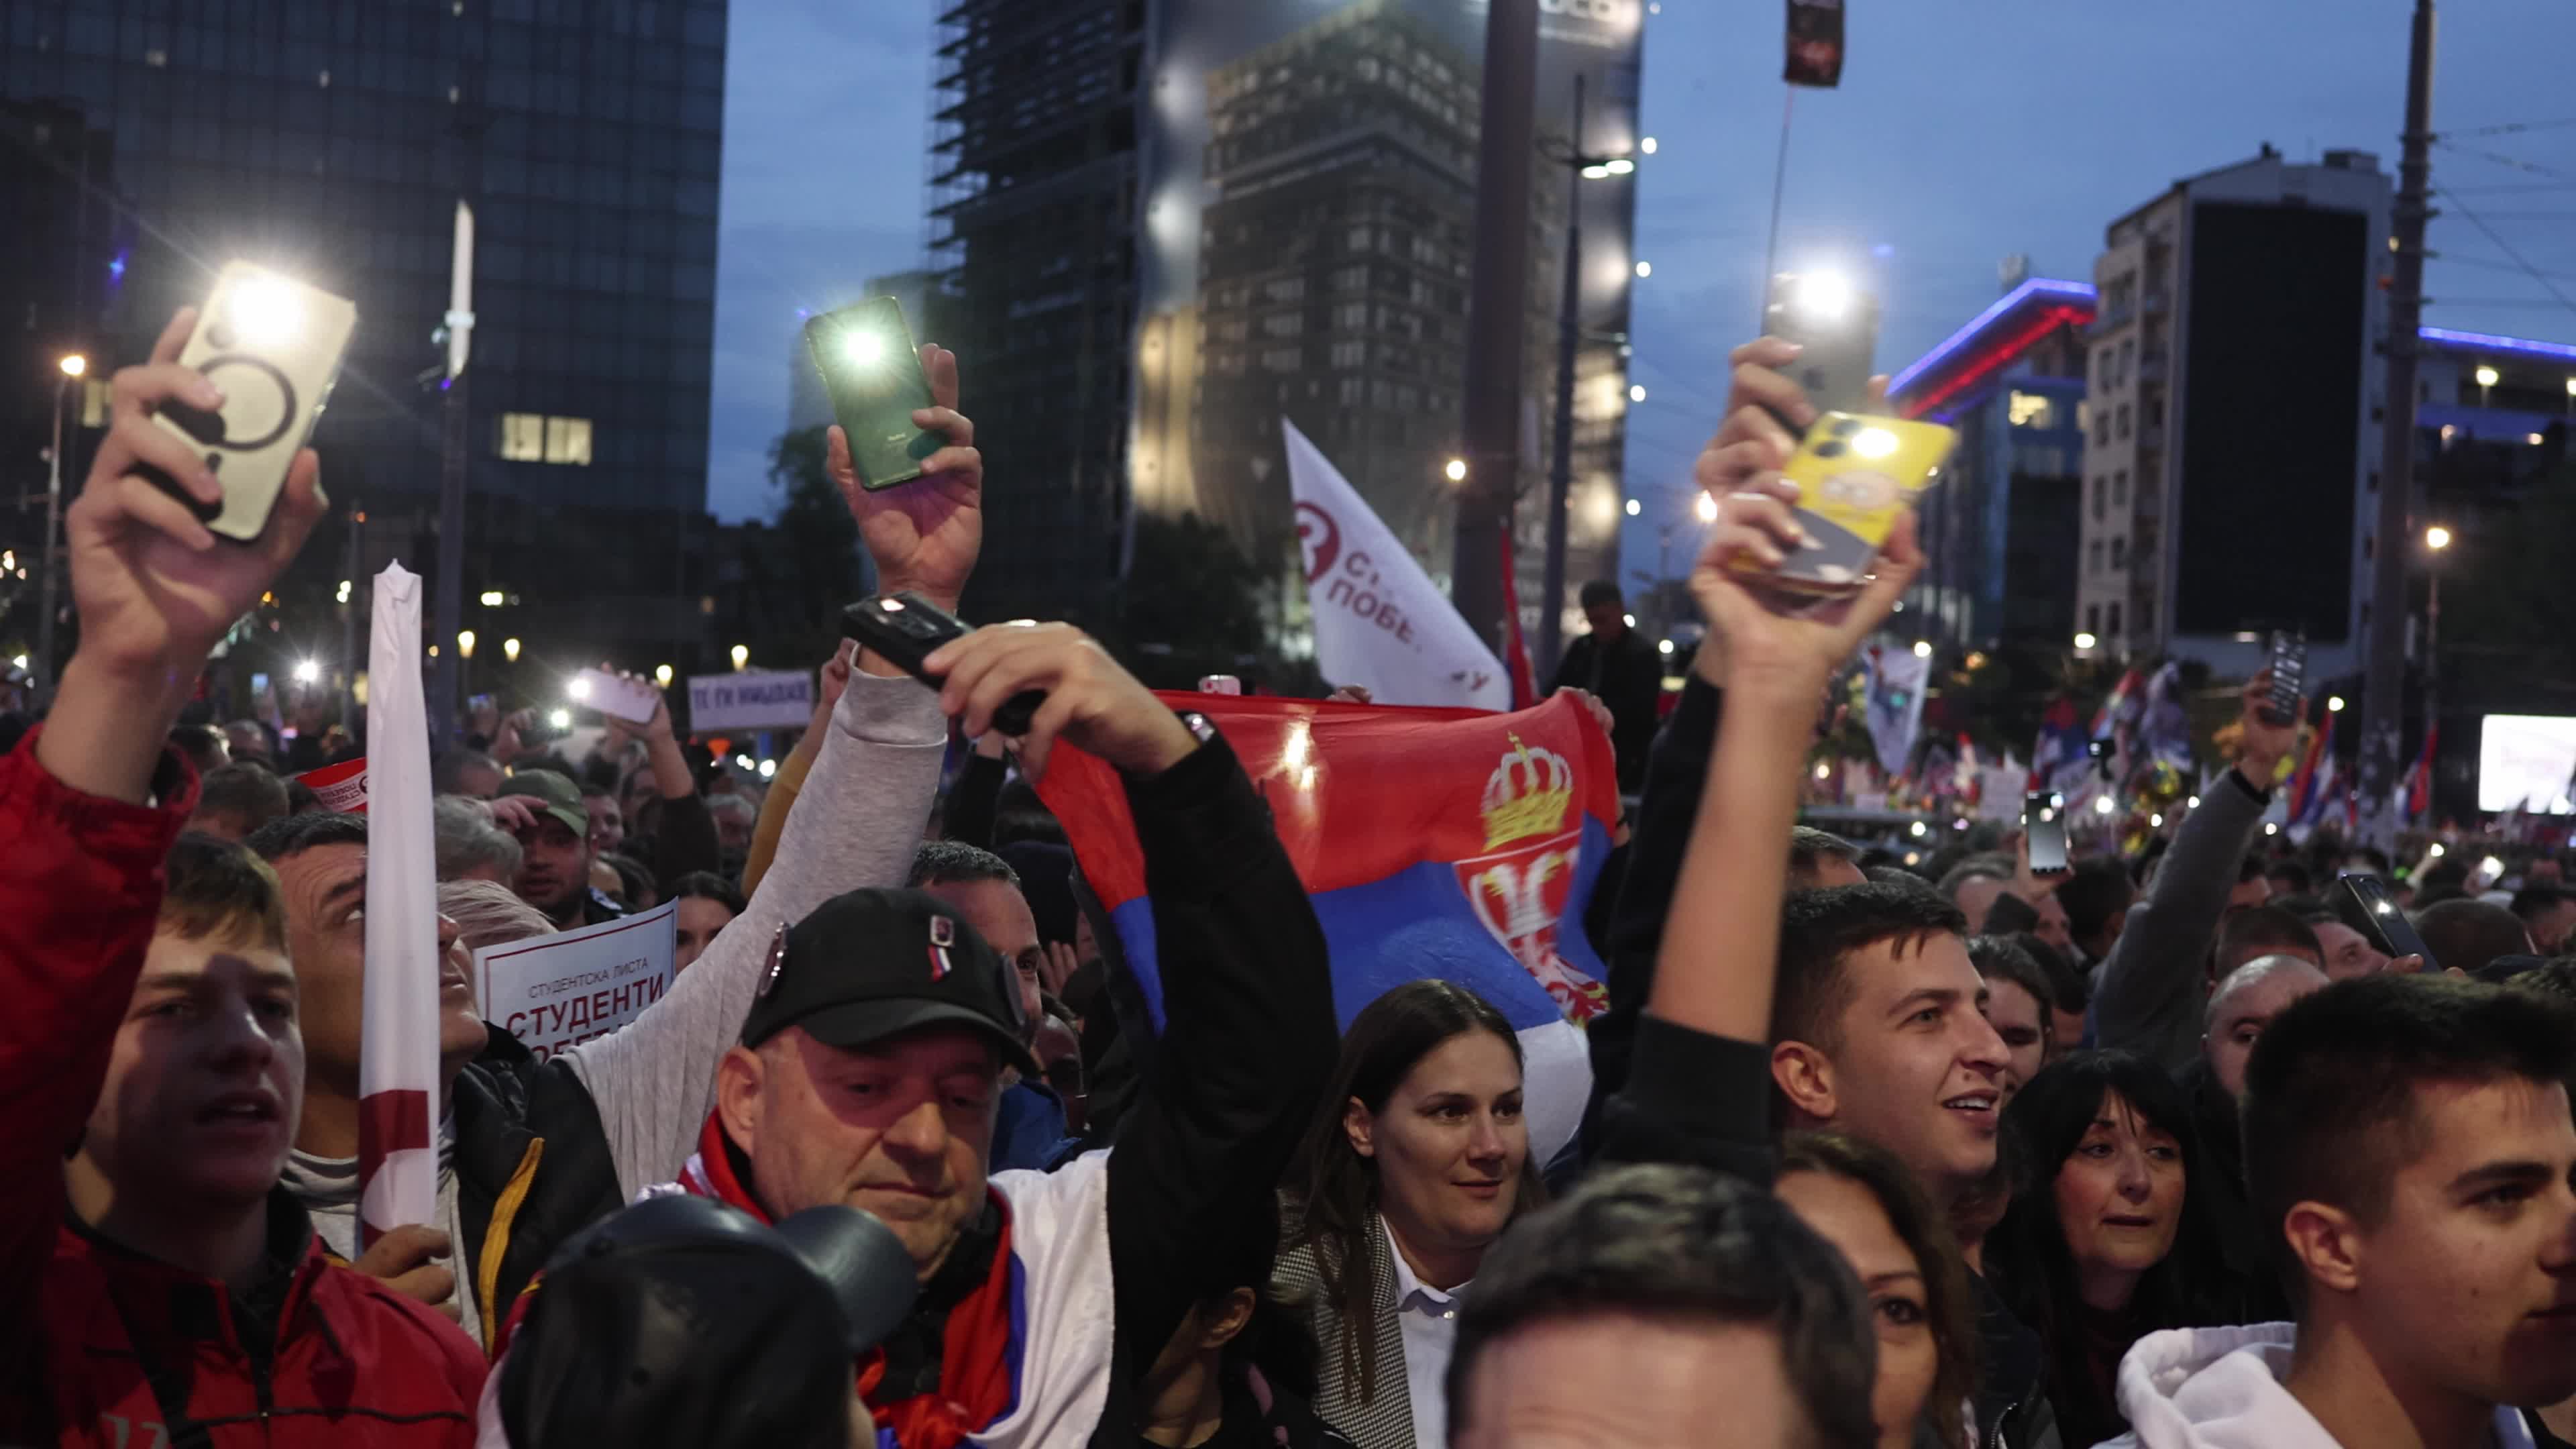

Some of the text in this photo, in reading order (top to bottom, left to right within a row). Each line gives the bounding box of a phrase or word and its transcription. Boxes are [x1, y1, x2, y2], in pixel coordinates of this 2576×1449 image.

[506, 971, 663, 1039] СТУДЕНТИ
[528, 957, 649, 999] СТУДЕНТСКА ЛИСТА
